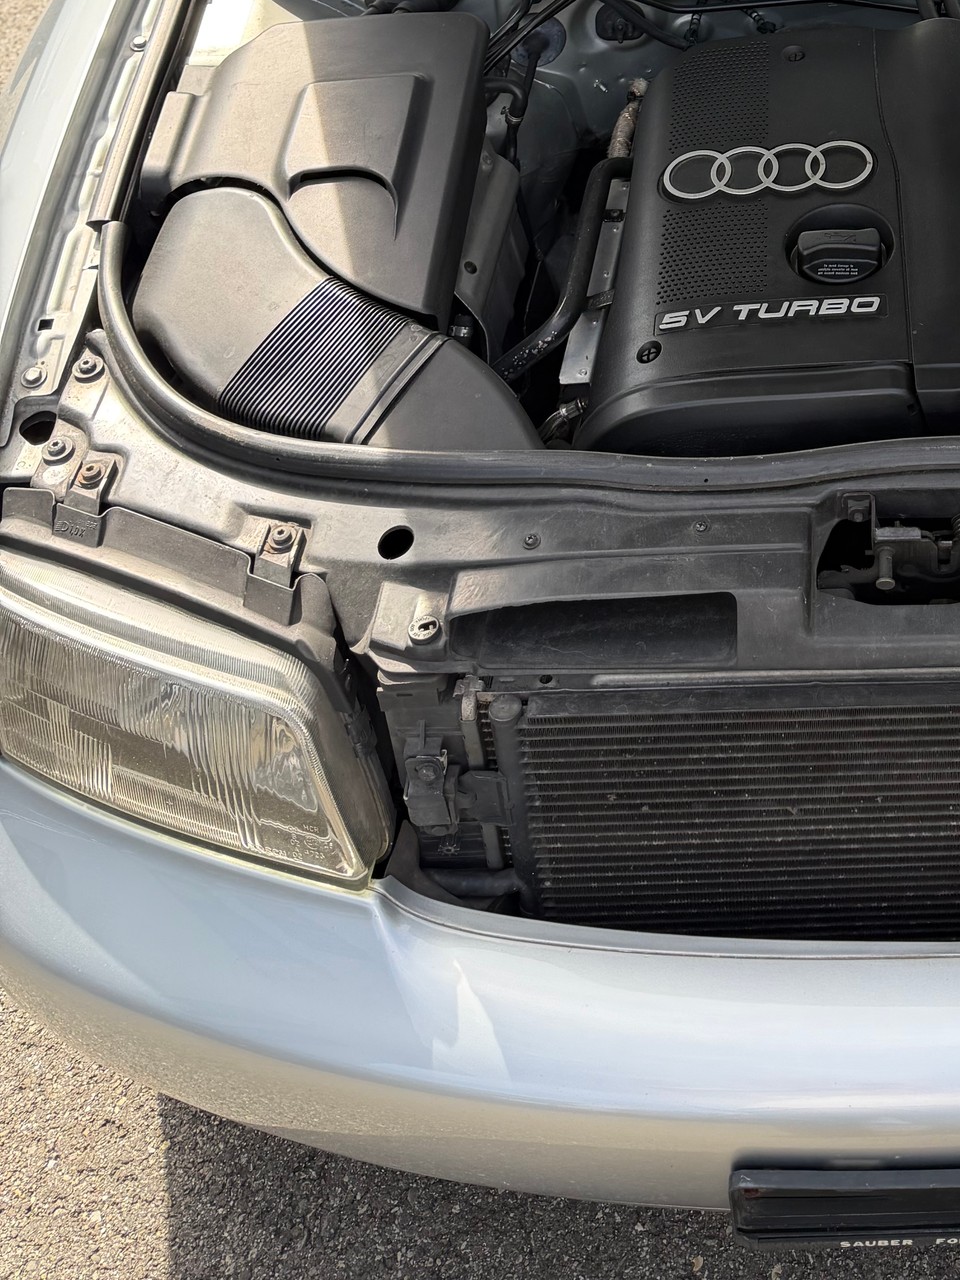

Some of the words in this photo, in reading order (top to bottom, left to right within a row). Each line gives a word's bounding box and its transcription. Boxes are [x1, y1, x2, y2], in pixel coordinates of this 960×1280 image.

[659, 306, 721, 330] 5V
[733, 296, 880, 320] TURBO
[840, 1240, 914, 1248] SAUBER
